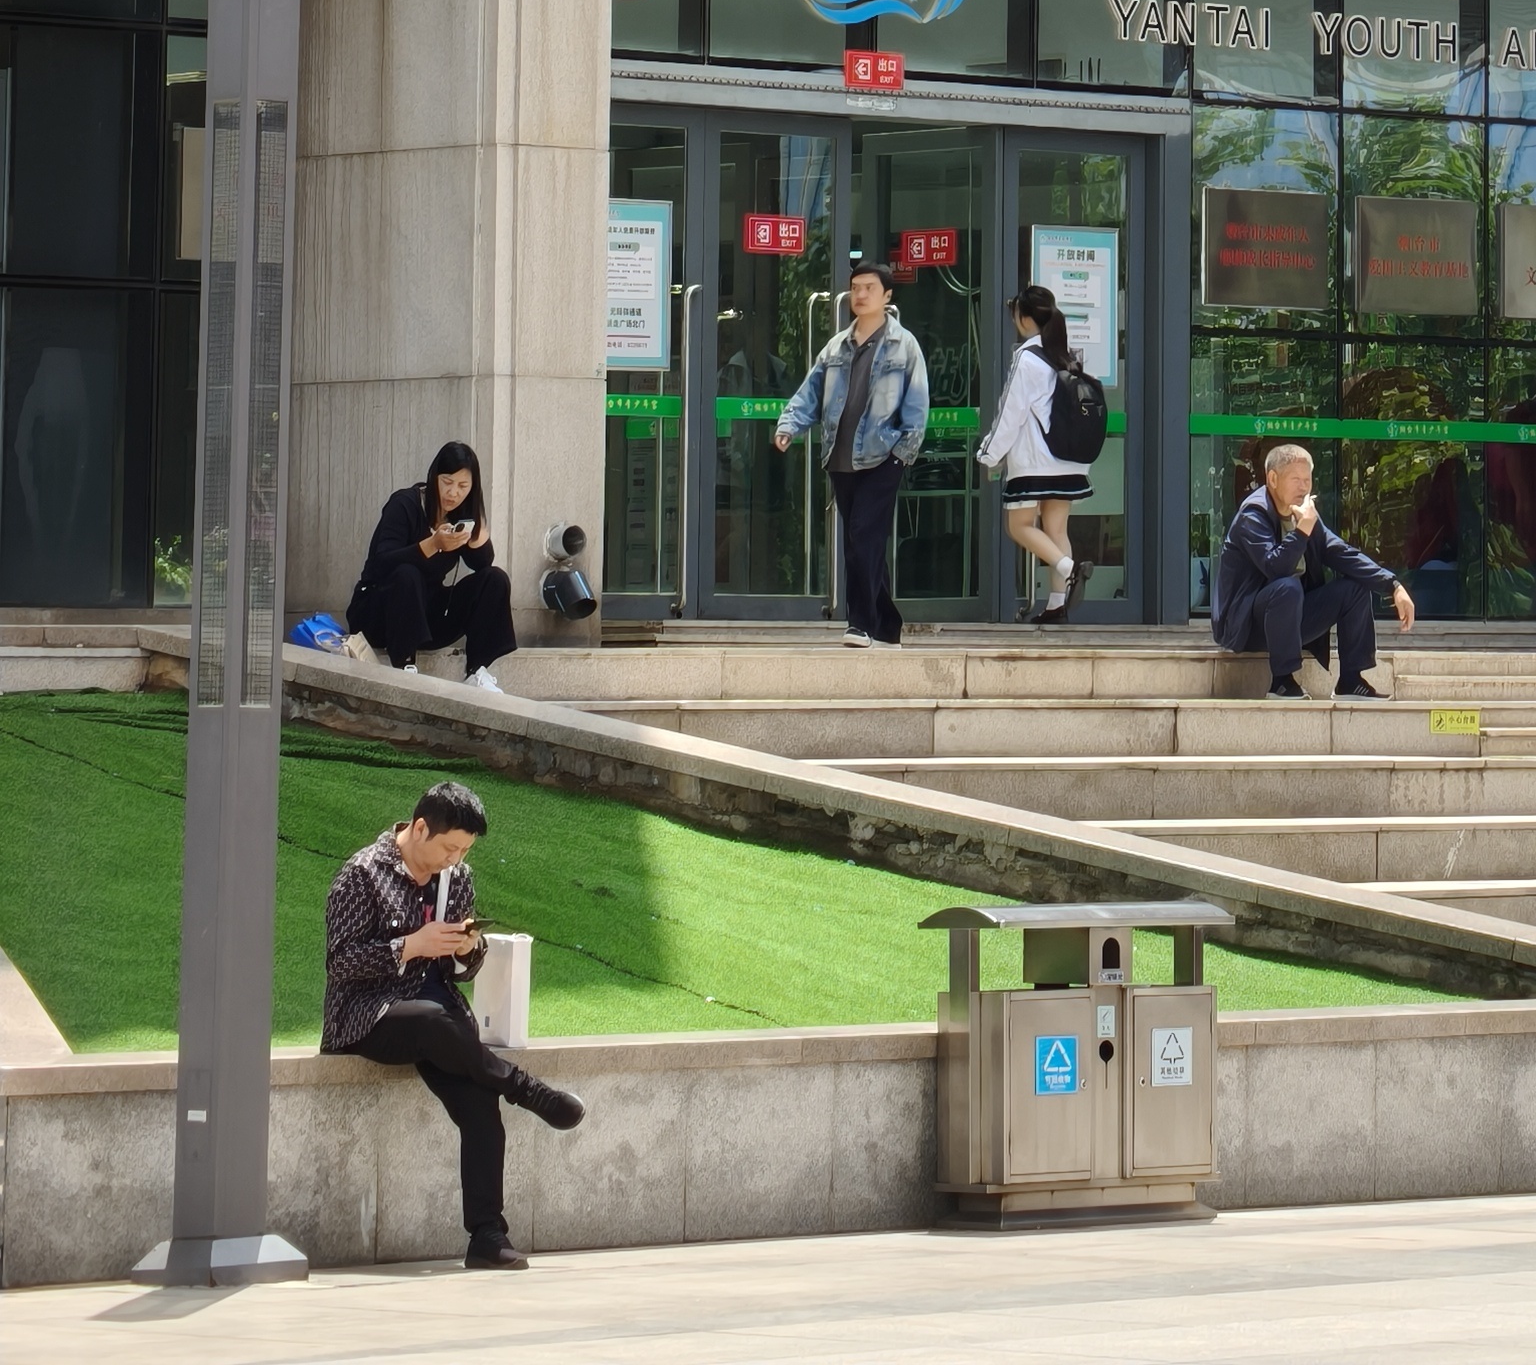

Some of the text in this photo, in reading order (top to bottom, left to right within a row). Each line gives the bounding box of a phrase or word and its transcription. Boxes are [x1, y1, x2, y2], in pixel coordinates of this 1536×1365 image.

[1312, 12, 1459, 63] YOUTH
[878, 58, 896, 72] 出口
[880, 75, 894, 84] EXIT
[779, 223, 800, 238] 出口
[781, 239, 797, 248] EXIT
[931, 235, 948, 249] 出口
[933, 251, 946, 260] EXIT
[1057, 249, 1096, 262] 开放时间
